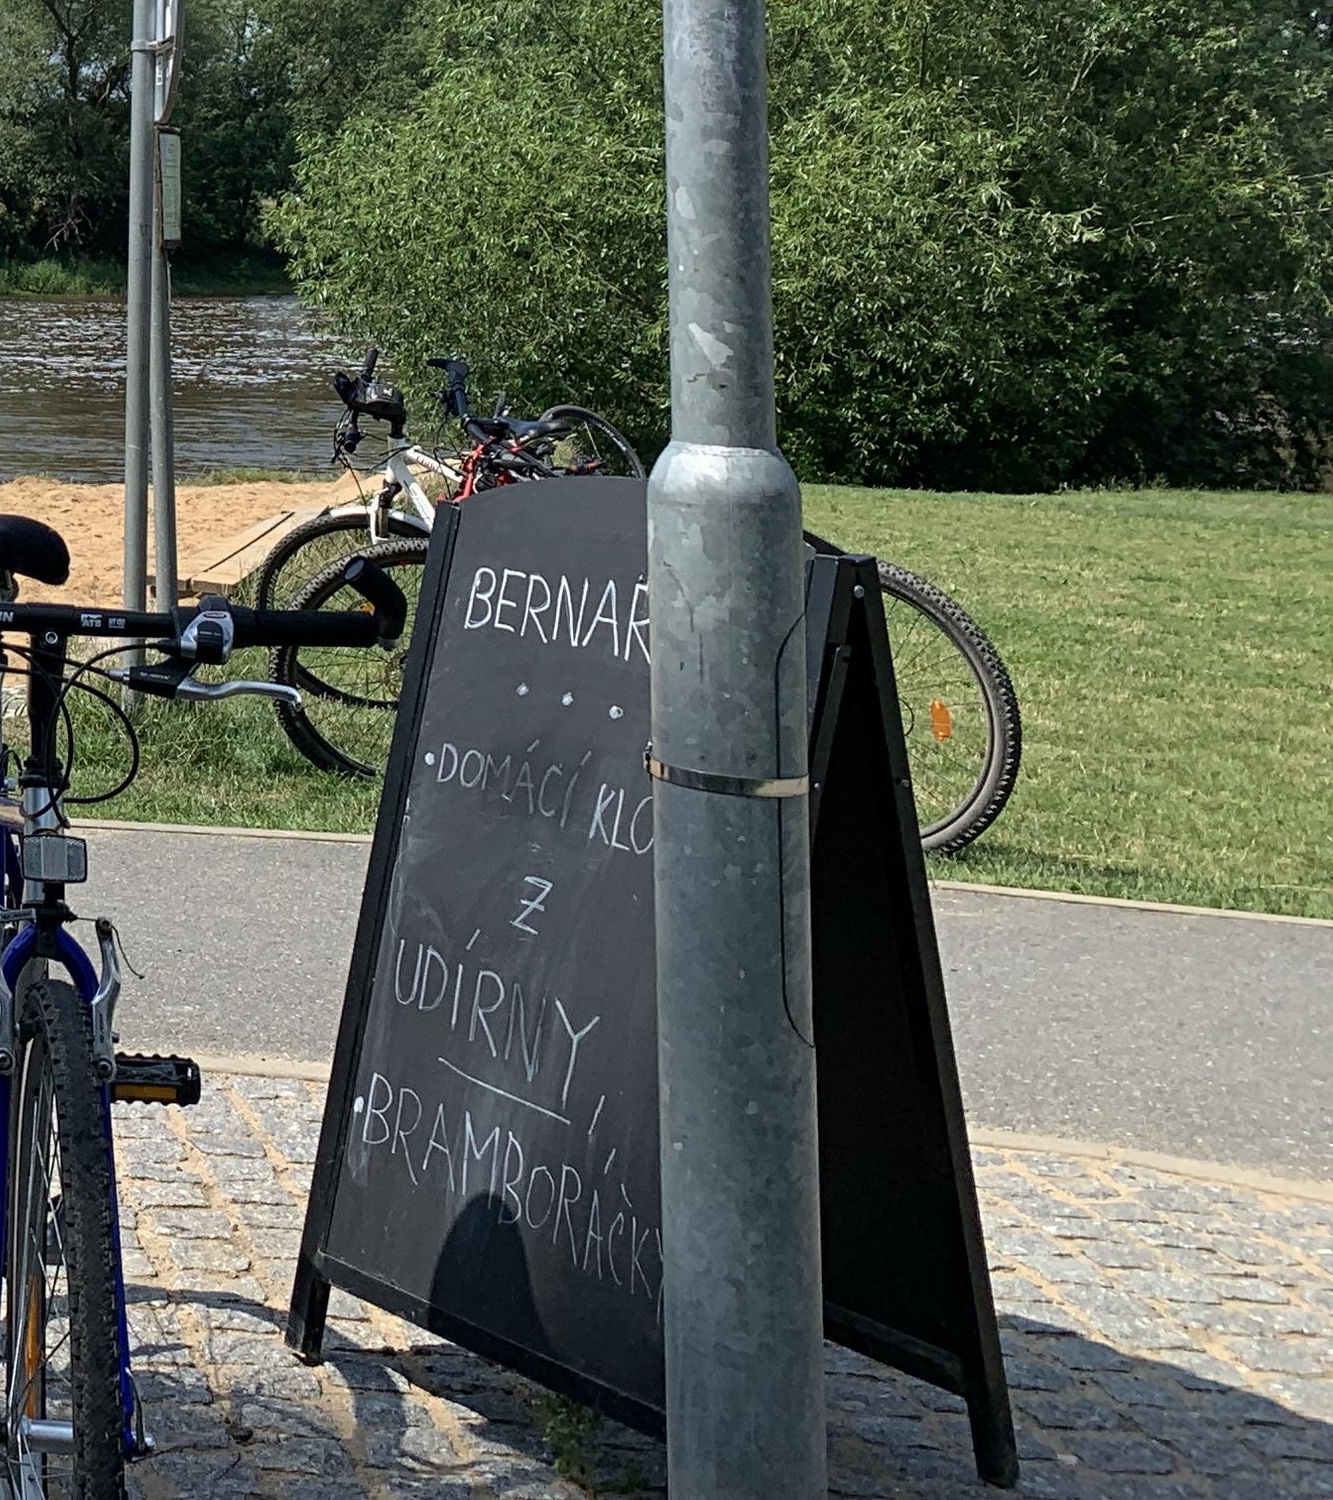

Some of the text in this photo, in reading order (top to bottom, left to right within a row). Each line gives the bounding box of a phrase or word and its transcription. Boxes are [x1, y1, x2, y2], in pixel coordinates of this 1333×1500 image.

[463, 566, 651, 666] BERNAR
[589, 783, 655, 855] KLO
[509, 875, 553, 935] Z
[394, 928, 600, 1111] UDÍRNY
